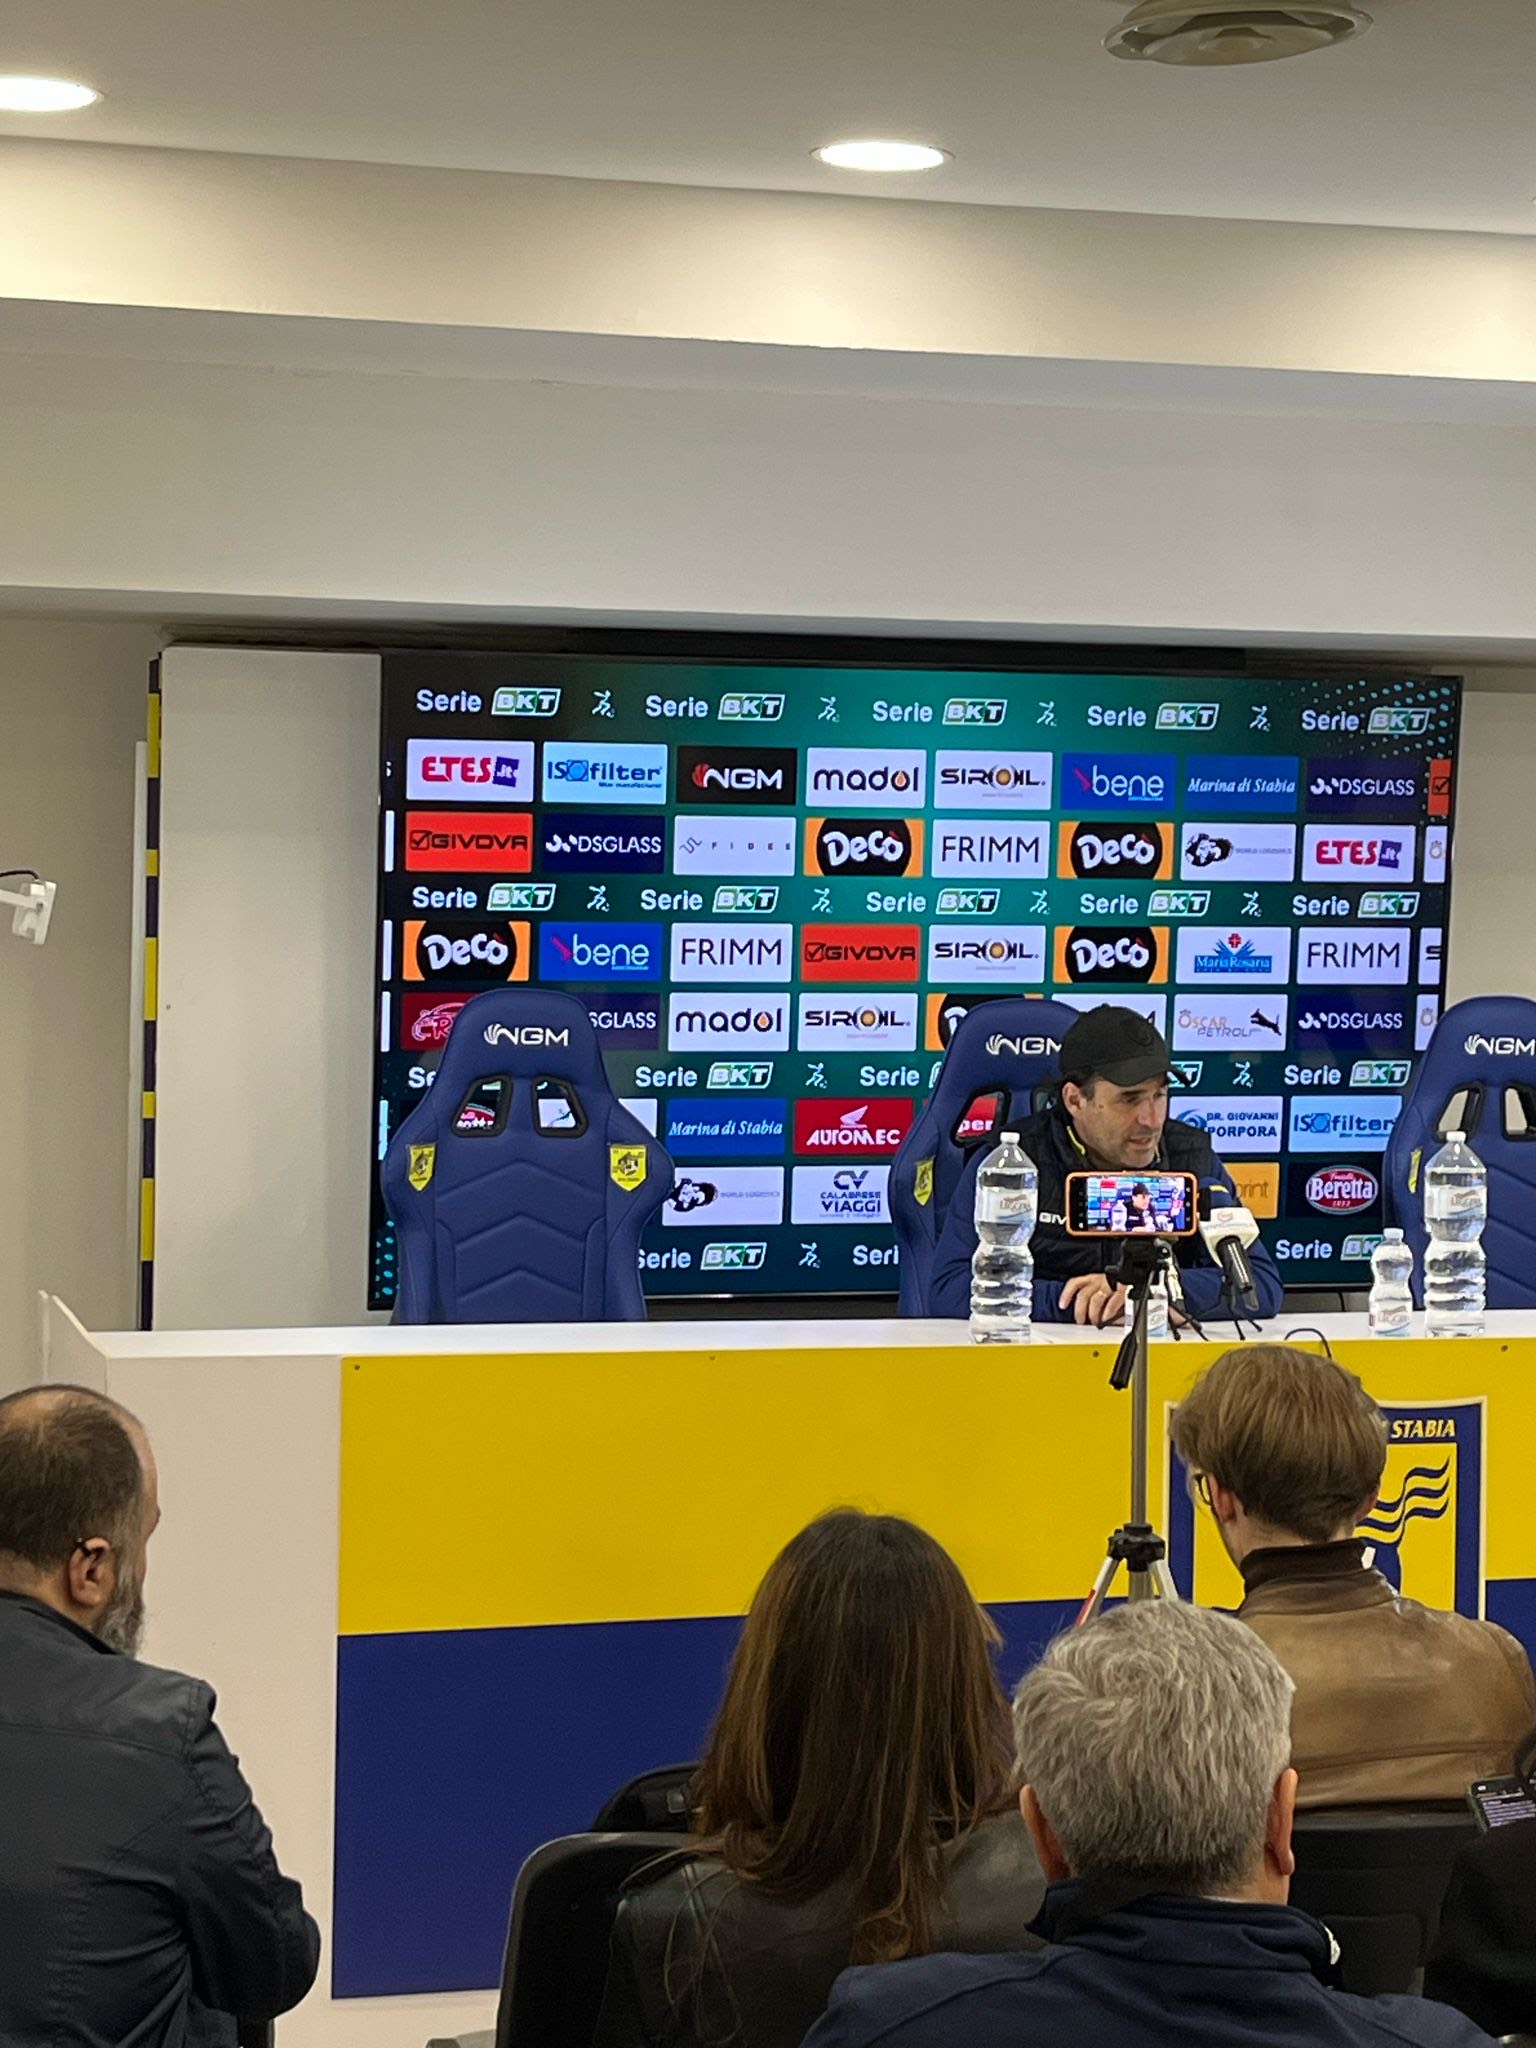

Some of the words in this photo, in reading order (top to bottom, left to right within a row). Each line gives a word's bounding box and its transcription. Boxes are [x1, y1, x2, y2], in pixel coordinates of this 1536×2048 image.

[416, 689, 482, 713] Serie
[494, 691, 557, 712] BKT
[645, 695, 709, 718] Serie
[721, 698, 782, 717] BKT
[872, 700, 933, 723] Serie
[945, 702, 1003, 721] BKT
[1087, 705, 1147, 727] Serie
[1158, 707, 1216, 726] BKT
[1301, 709, 1360, 731] Serie
[1371, 712, 1427, 731] BKT
[703, 767, 783, 790] NGM
[813, 766, 920, 792] madol
[1092, 765, 1164, 796] bene
[1187, 777, 1236, 793] Marina
[1237, 776, 1251, 792] di
[1253, 777, 1296, 793] Stabia
[1339, 777, 1415, 796] DSGLASS
[430, 833, 528, 850] GIVOVA
[578, 835, 662, 853] DSGLASS
[941, 835, 1040, 863] FRIMM
[412, 886, 478, 909] Serie
[490, 888, 552, 906] BKT
[640, 889, 703, 911] Serie
[716, 890, 775, 909] BKT
[866, 891, 927, 913] Serie
[938, 893, 996, 911] BKT
[1079, 893, 1139, 915] Serie
[1150, 895, 1206, 913] BKT
[1292, 895, 1350, 916] Serie
[1361, 896, 1417, 914] BKT
[572, 933, 649, 966] bene
[681, 938, 782, 966] FRIMM
[825, 945, 916, 962] GIVOVA
[1306, 942, 1400, 968] FRIMM
[588, 1011, 657, 1029] SGLASS
[675, 1007, 782, 1033] madol
[1327, 1012, 1403, 1030] DSGLASS
[501, 1025, 569, 1046] NGM
[1475, 1036, 1536, 1056] NGM
[635, 1066, 698, 1088] Serie
[710, 1066, 769, 1085] BKT
[859, 1066, 920, 1087] Serie
[1284, 1065, 1342, 1086] Serie
[1351, 1064, 1408, 1083] BKT
[668, 1121, 720, 1137] Marina
[721, 1121, 736, 1136] di
[737, 1119, 783, 1136] Stabia
[833, 1170, 870, 1190] CV
[1309, 1177, 1373, 1201] Beretta
[821, 1200, 881, 1213] VIAGGI
[704, 1247, 762, 1265] BKT
[852, 1245, 899, 1266] Seri
[1276, 1239, 1333, 1260] Serie
[1390, 1419, 1456, 1439] STABIA
